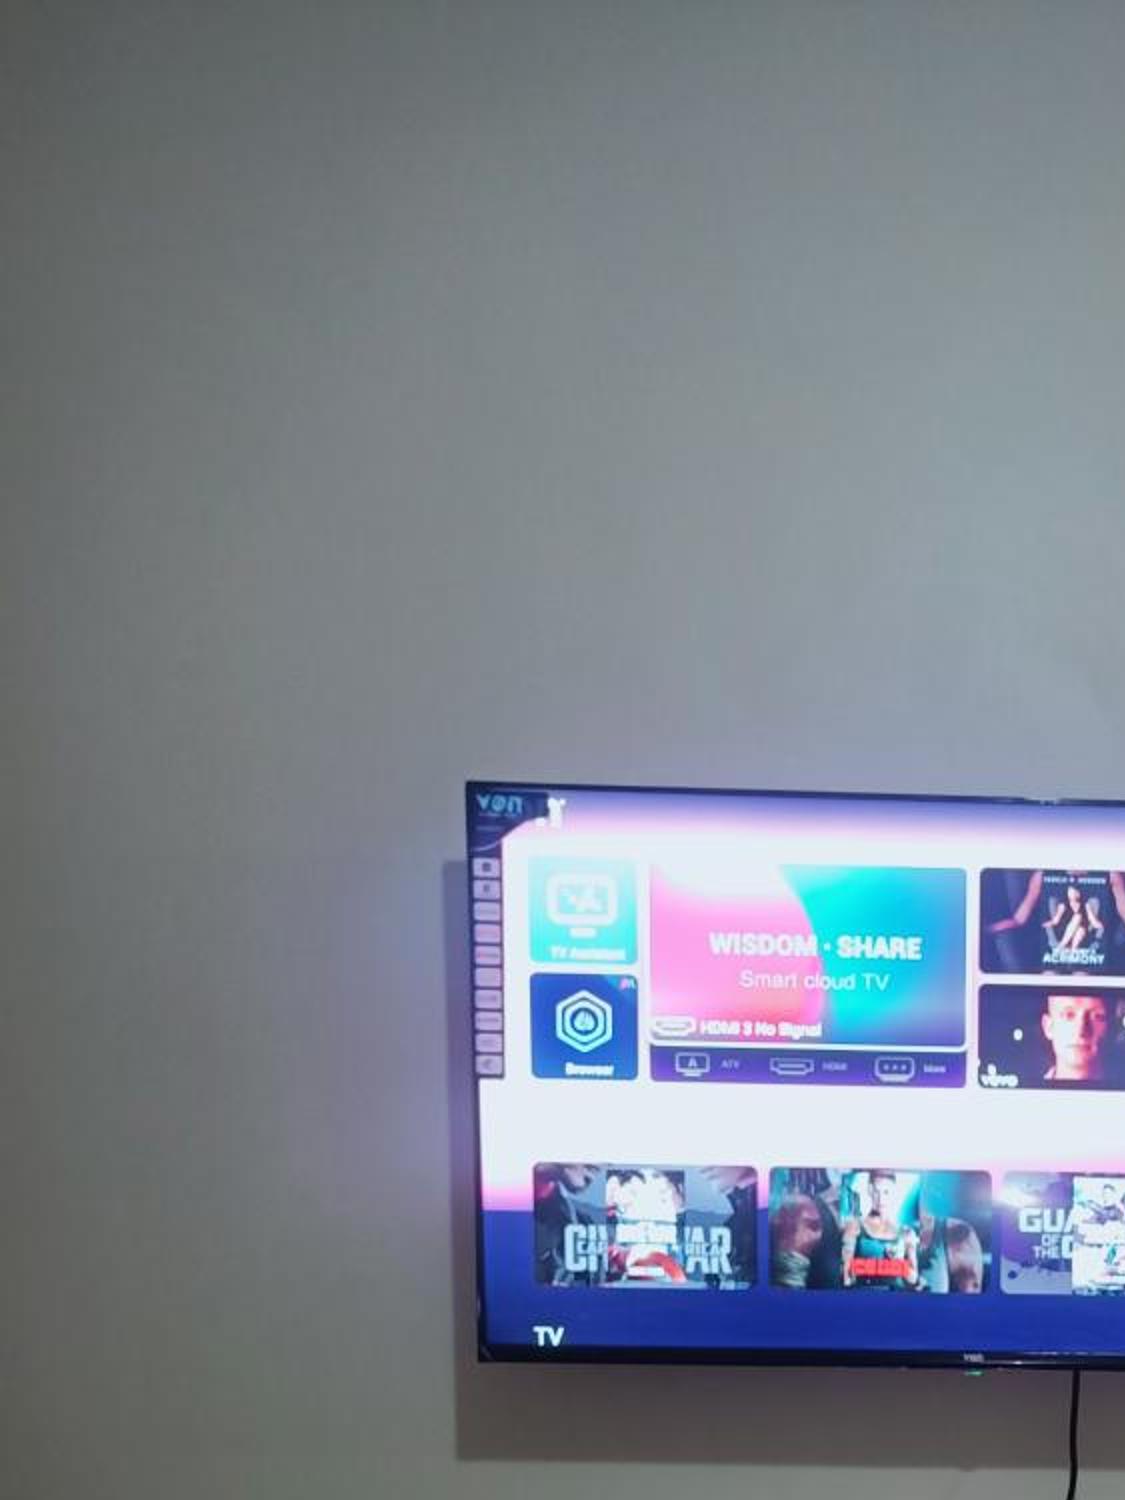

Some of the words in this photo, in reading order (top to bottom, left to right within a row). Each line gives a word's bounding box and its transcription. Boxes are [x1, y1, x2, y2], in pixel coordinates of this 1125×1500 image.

[708, 932, 819, 957] WISDOM
[837, 934, 923, 961] SHARE
[739, 970, 798, 989] Smart
[804, 972, 857, 991] cloud
[862, 973, 891, 991] TV
[532, 1325, 565, 1347] TV
